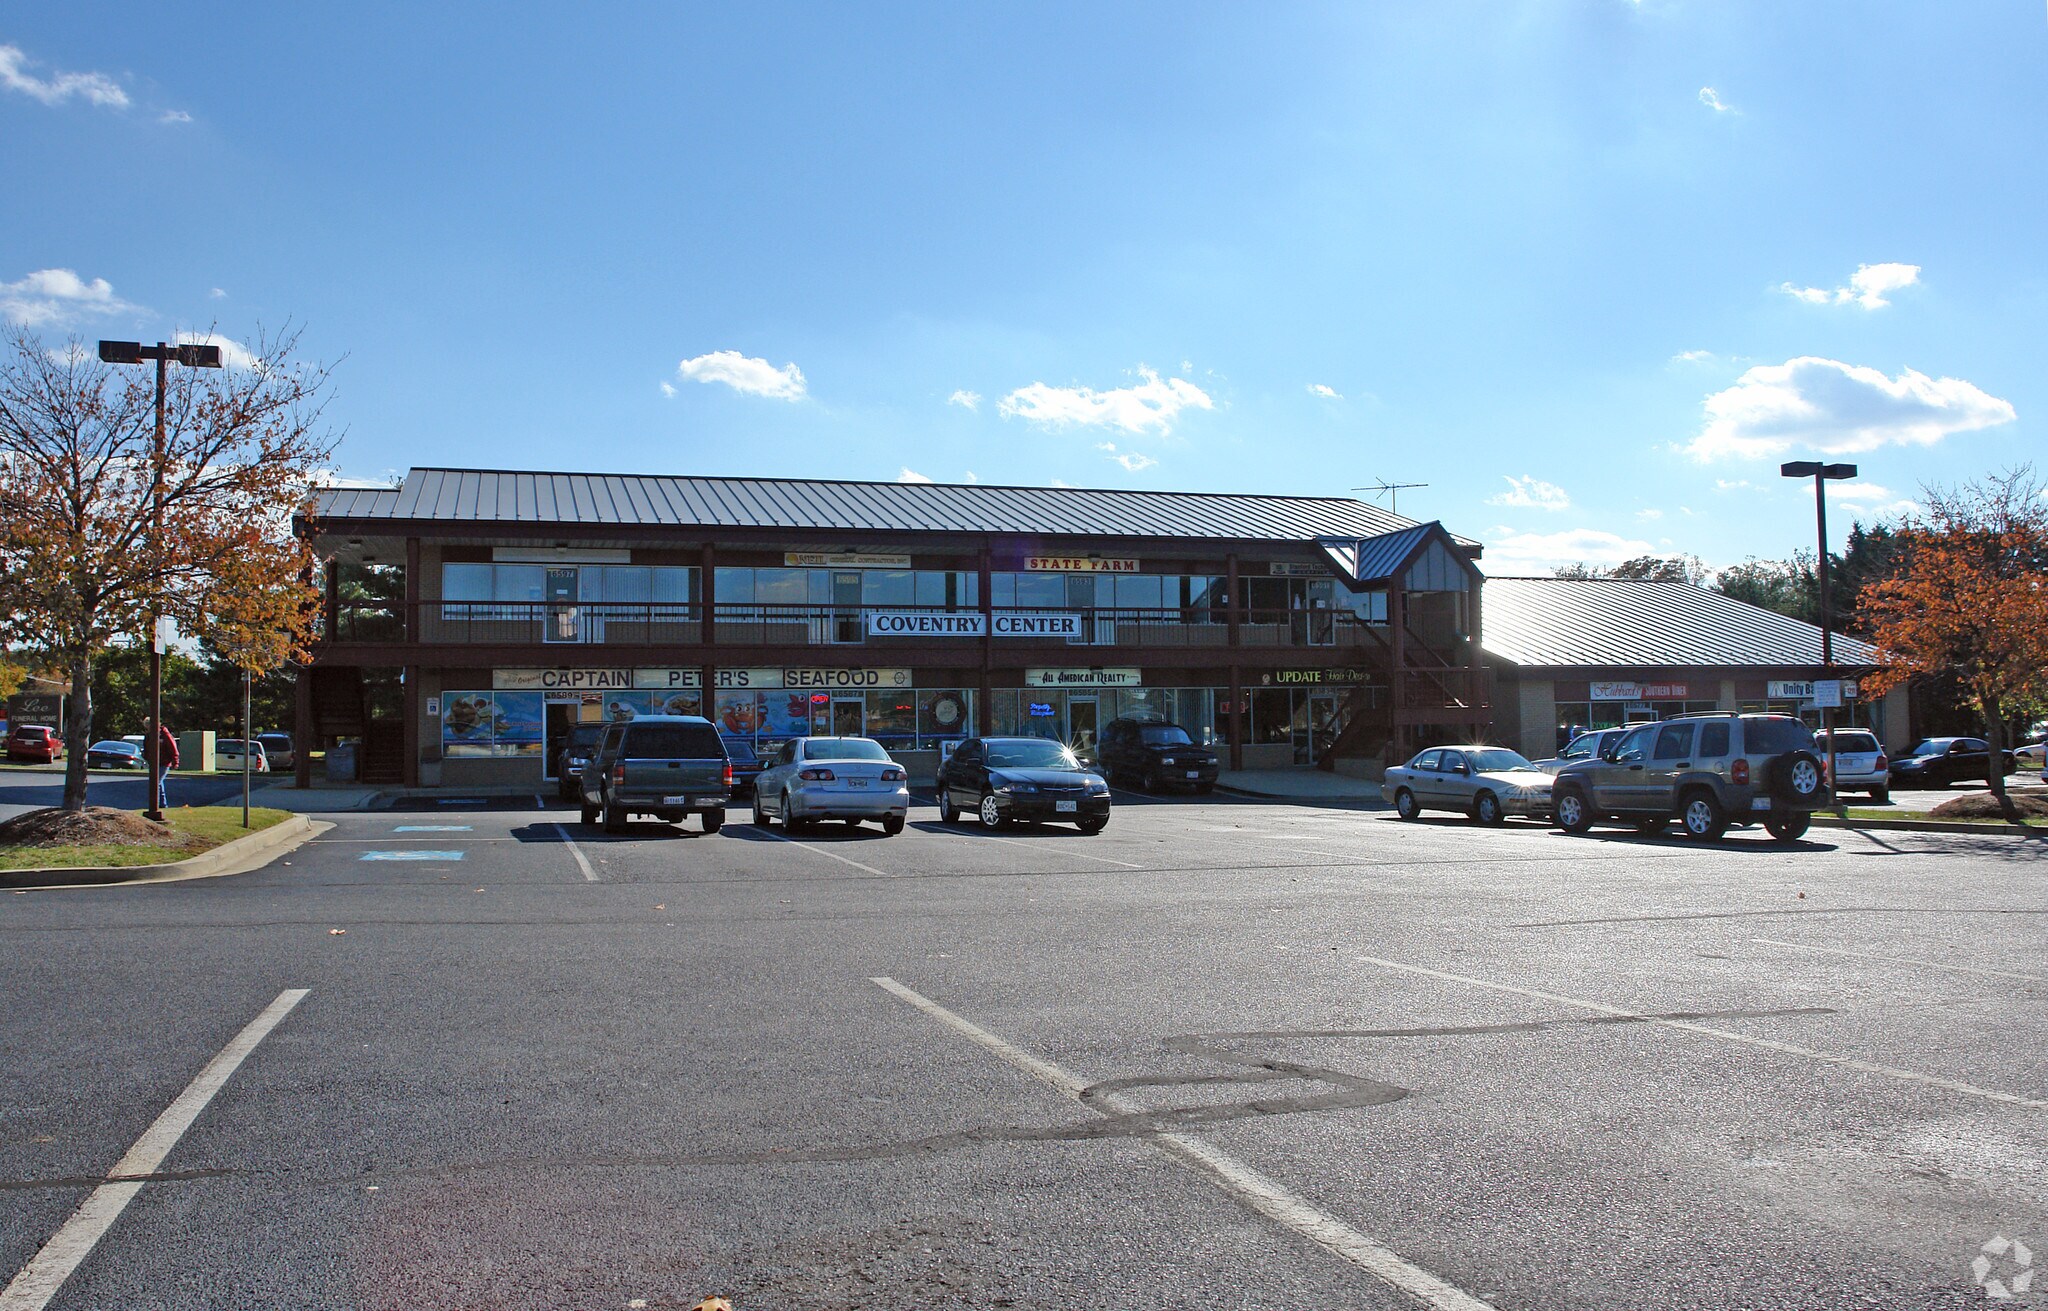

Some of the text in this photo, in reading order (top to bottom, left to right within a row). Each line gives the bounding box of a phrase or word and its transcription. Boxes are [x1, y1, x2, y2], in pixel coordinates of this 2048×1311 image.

[1030, 559, 1135, 571] STATE FARM
[876, 615, 1075, 633] COVENTRY CENTER
[542, 670, 630, 687] CAPTAIN
[786, 670, 879, 687] SEAFOOD
[1276, 670, 1322, 683] UPDATE
[1782, 682, 1804, 696] Unity
[811, 694, 829, 703] OPEN
[20, 699, 49, 713] Lee
